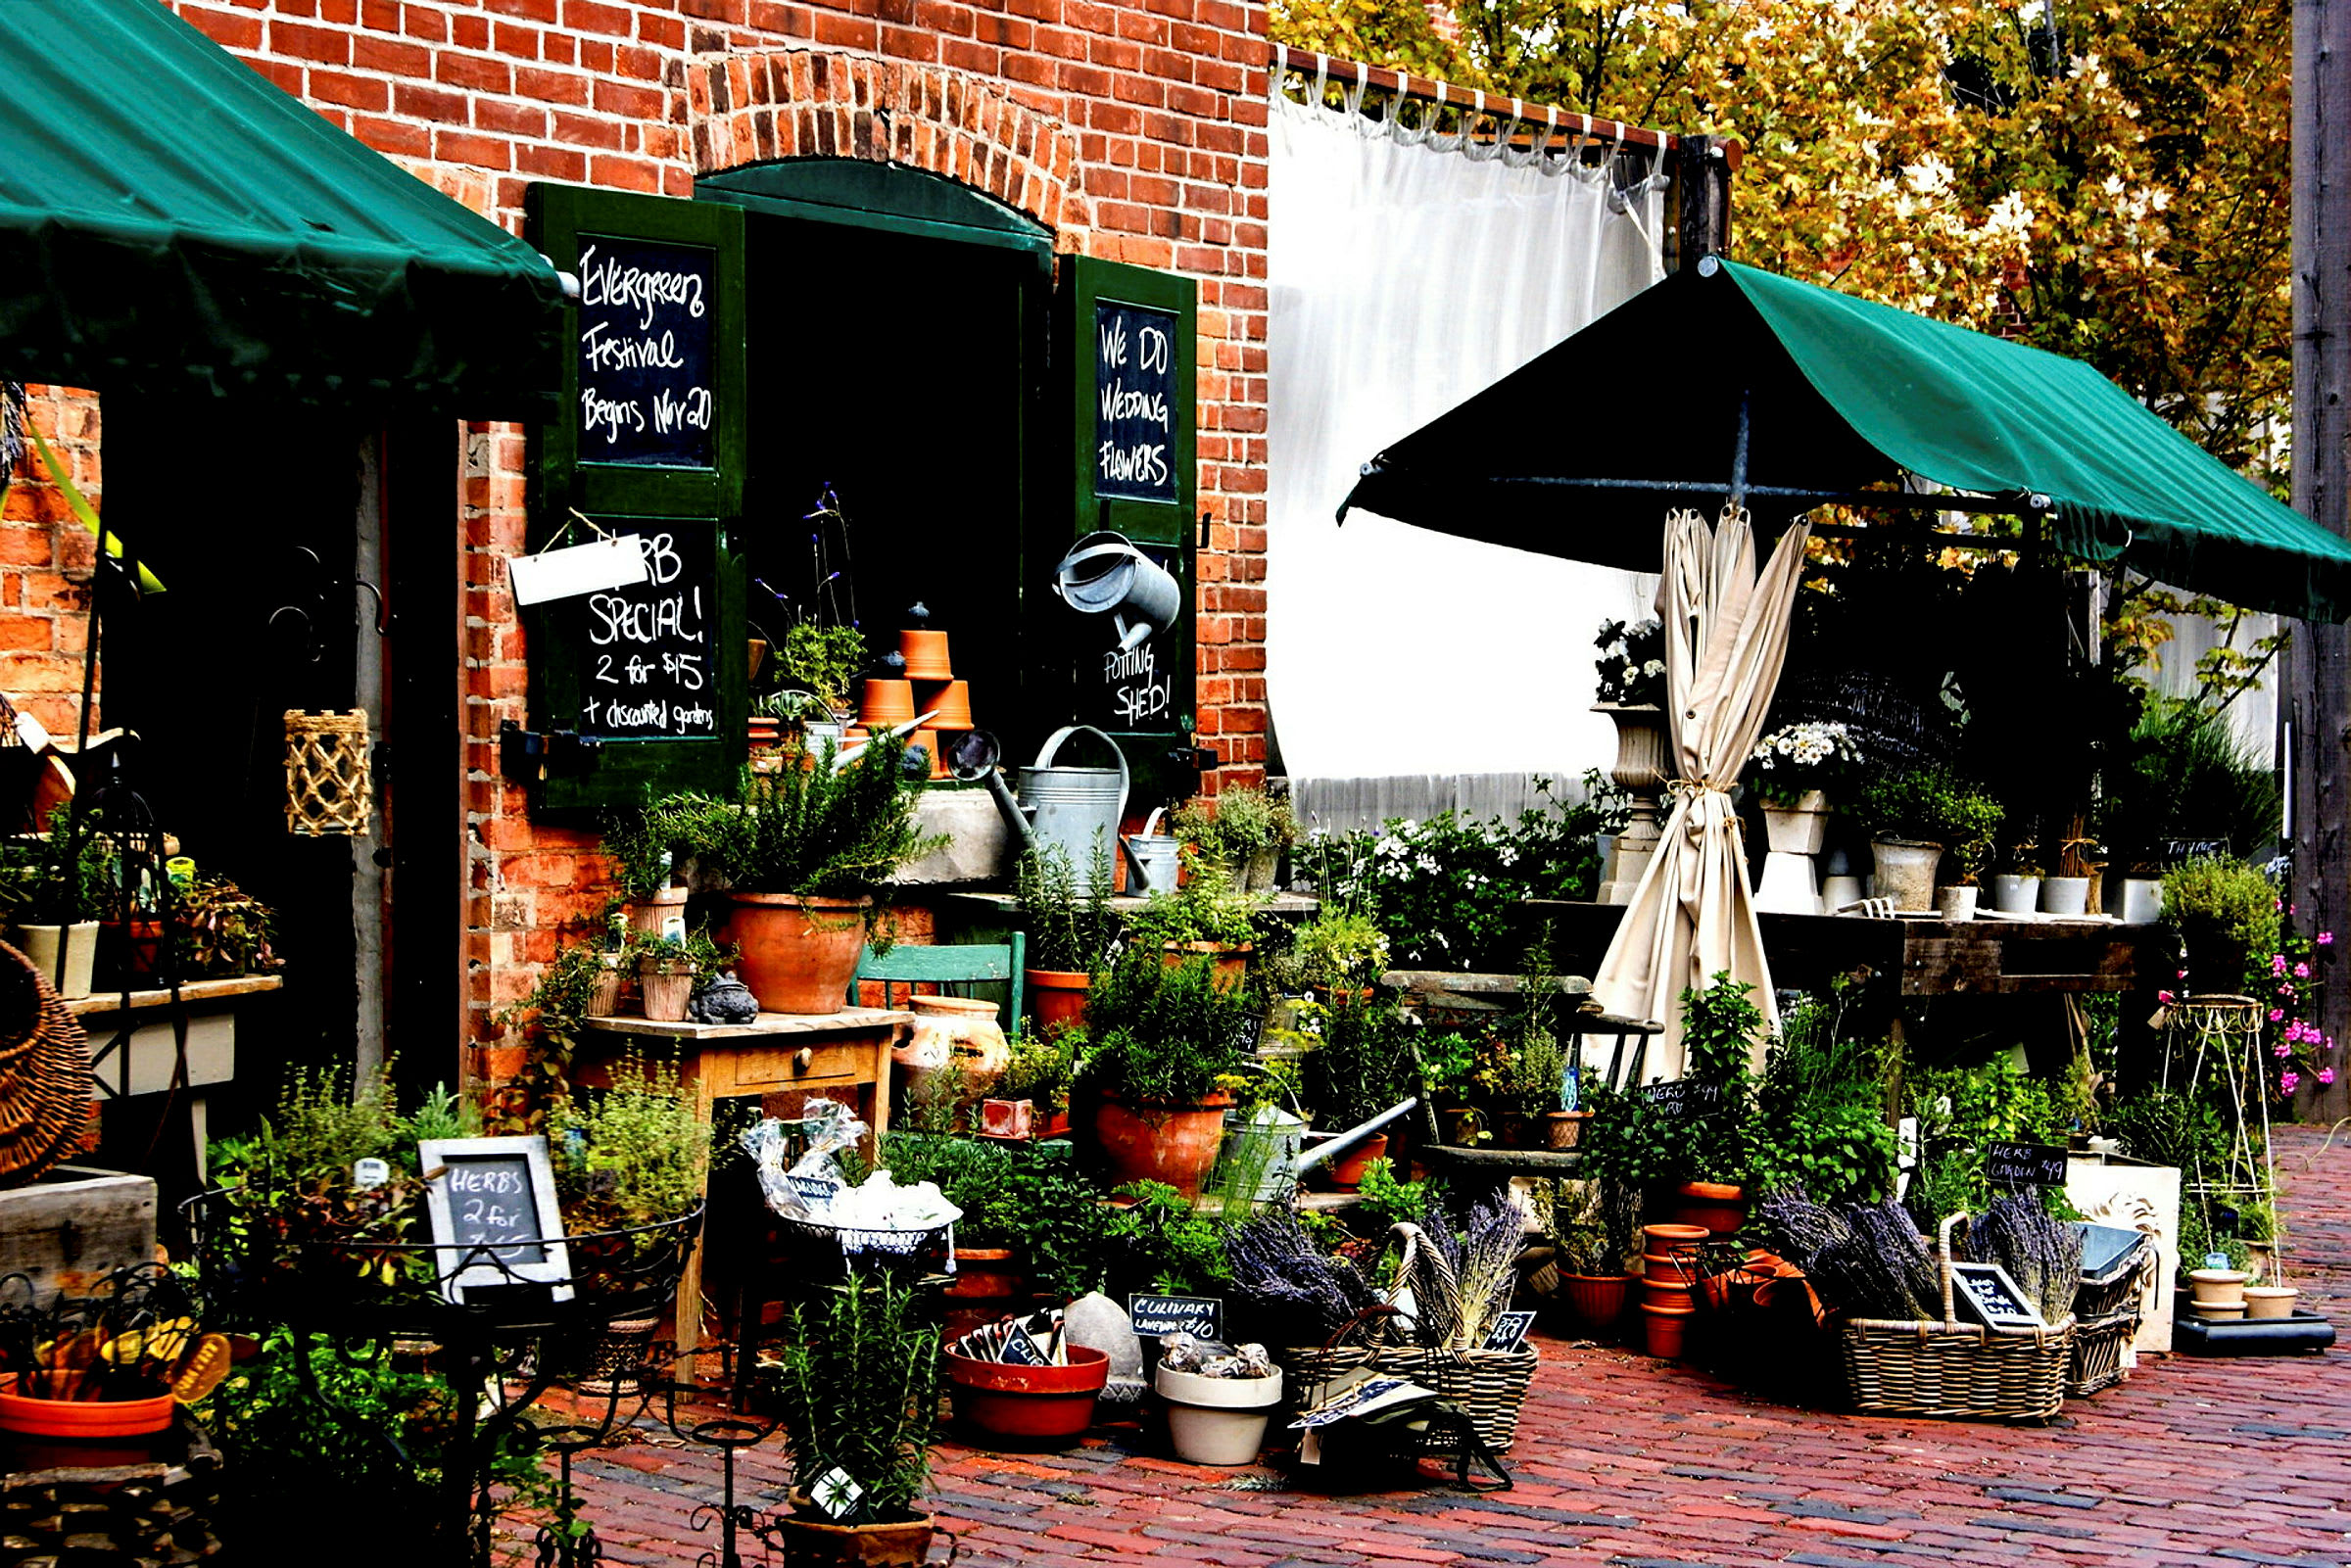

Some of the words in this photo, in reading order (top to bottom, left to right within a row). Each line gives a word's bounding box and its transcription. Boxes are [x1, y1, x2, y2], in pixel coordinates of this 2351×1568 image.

[1139, 326, 1169, 375] DO
[1098, 441, 1169, 486] FLOWERS
[589, 586, 703, 644] SPECIAL!
[596, 654, 619, 685] 2
[624, 655, 655, 686] for
[662, 651, 703, 690] $15
[1103, 642, 1154, 689] POTTING
[1114, 674, 1172, 727] SHED!
[1992, 1144, 2033, 1160] HERB
[450, 1167, 523, 1195] HERBS
[462, 1198, 485, 1224] 2
[486, 1205, 523, 1229] for
[1133, 1298, 1215, 1317] CULINARY
[1183, 1316, 1215, 1339] $10
